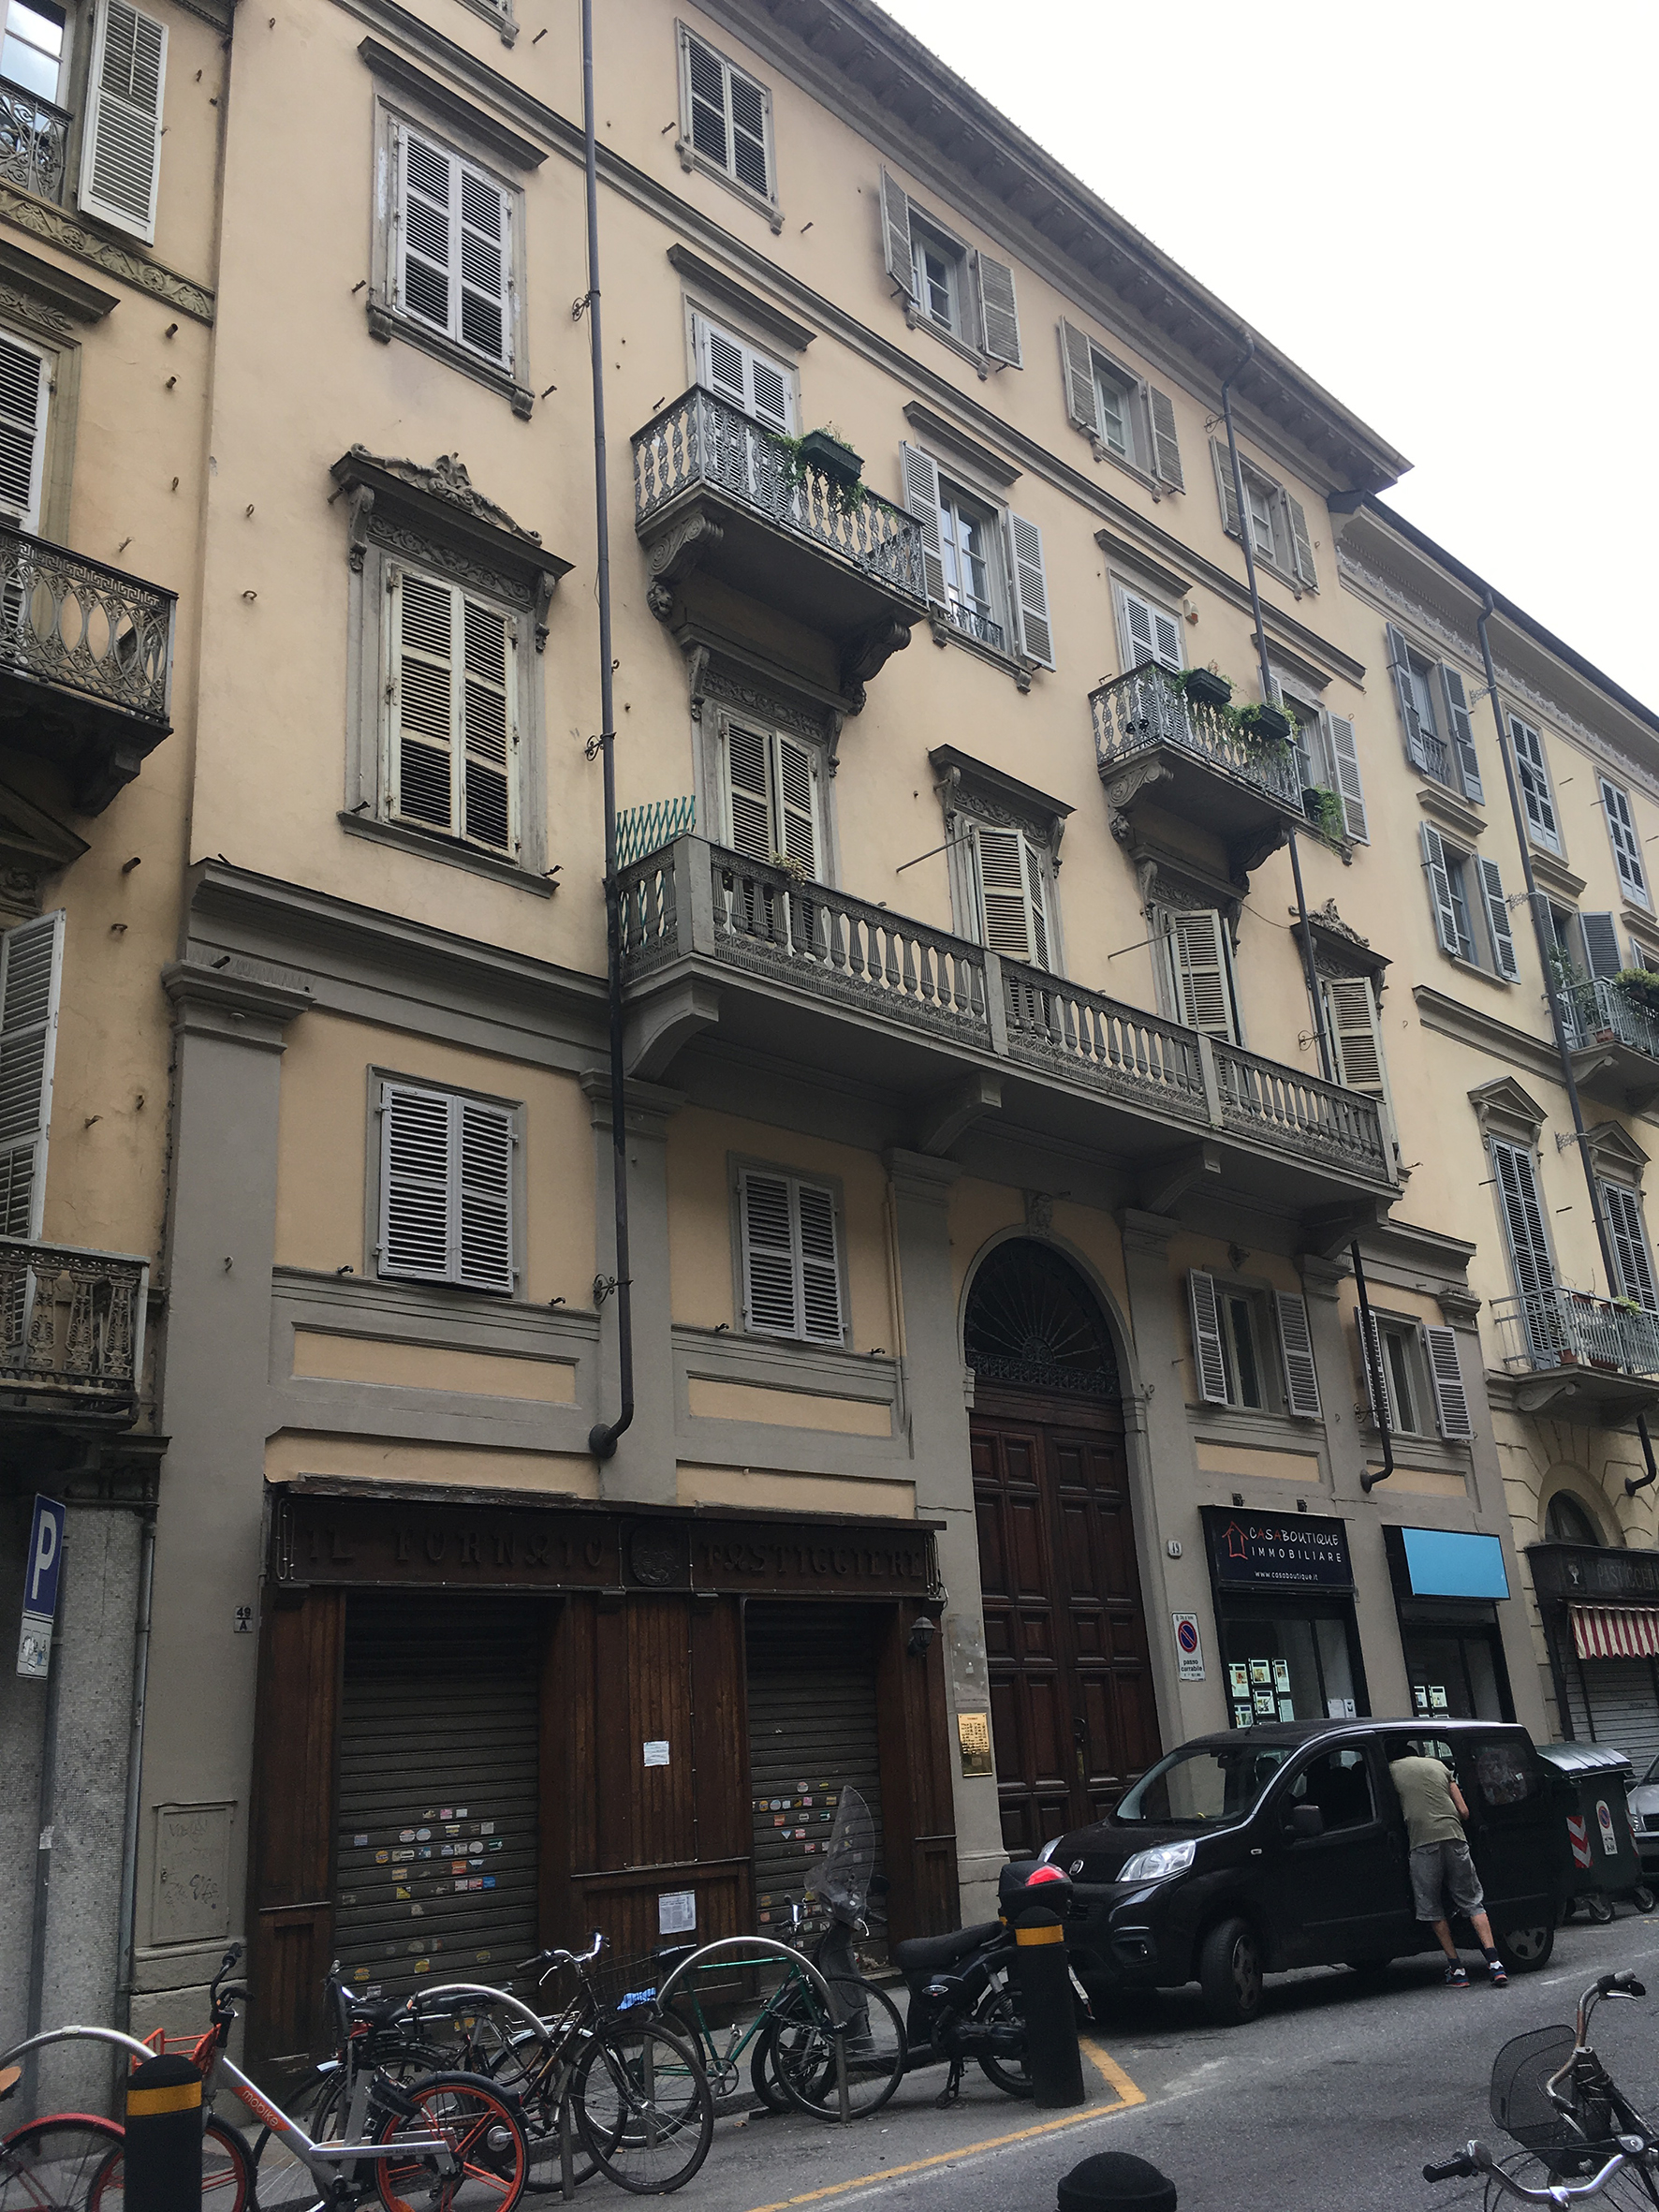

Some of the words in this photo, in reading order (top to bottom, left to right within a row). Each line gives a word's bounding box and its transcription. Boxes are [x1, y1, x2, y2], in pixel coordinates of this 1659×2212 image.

[306, 1527, 353, 1559] IL
[1249, 1526, 1339, 1546] CASABOUTIQUE
[31, 1510, 56, 1600] P
[1251, 1546, 1342, 1563] IMMOBILIARE
[1255, 1571, 1318, 1582] www.casaboutique.it
[236, 1607, 251, 1617] 49
[240, 1620, 247, 1630] A
[242, 2090, 279, 2127] mobike
